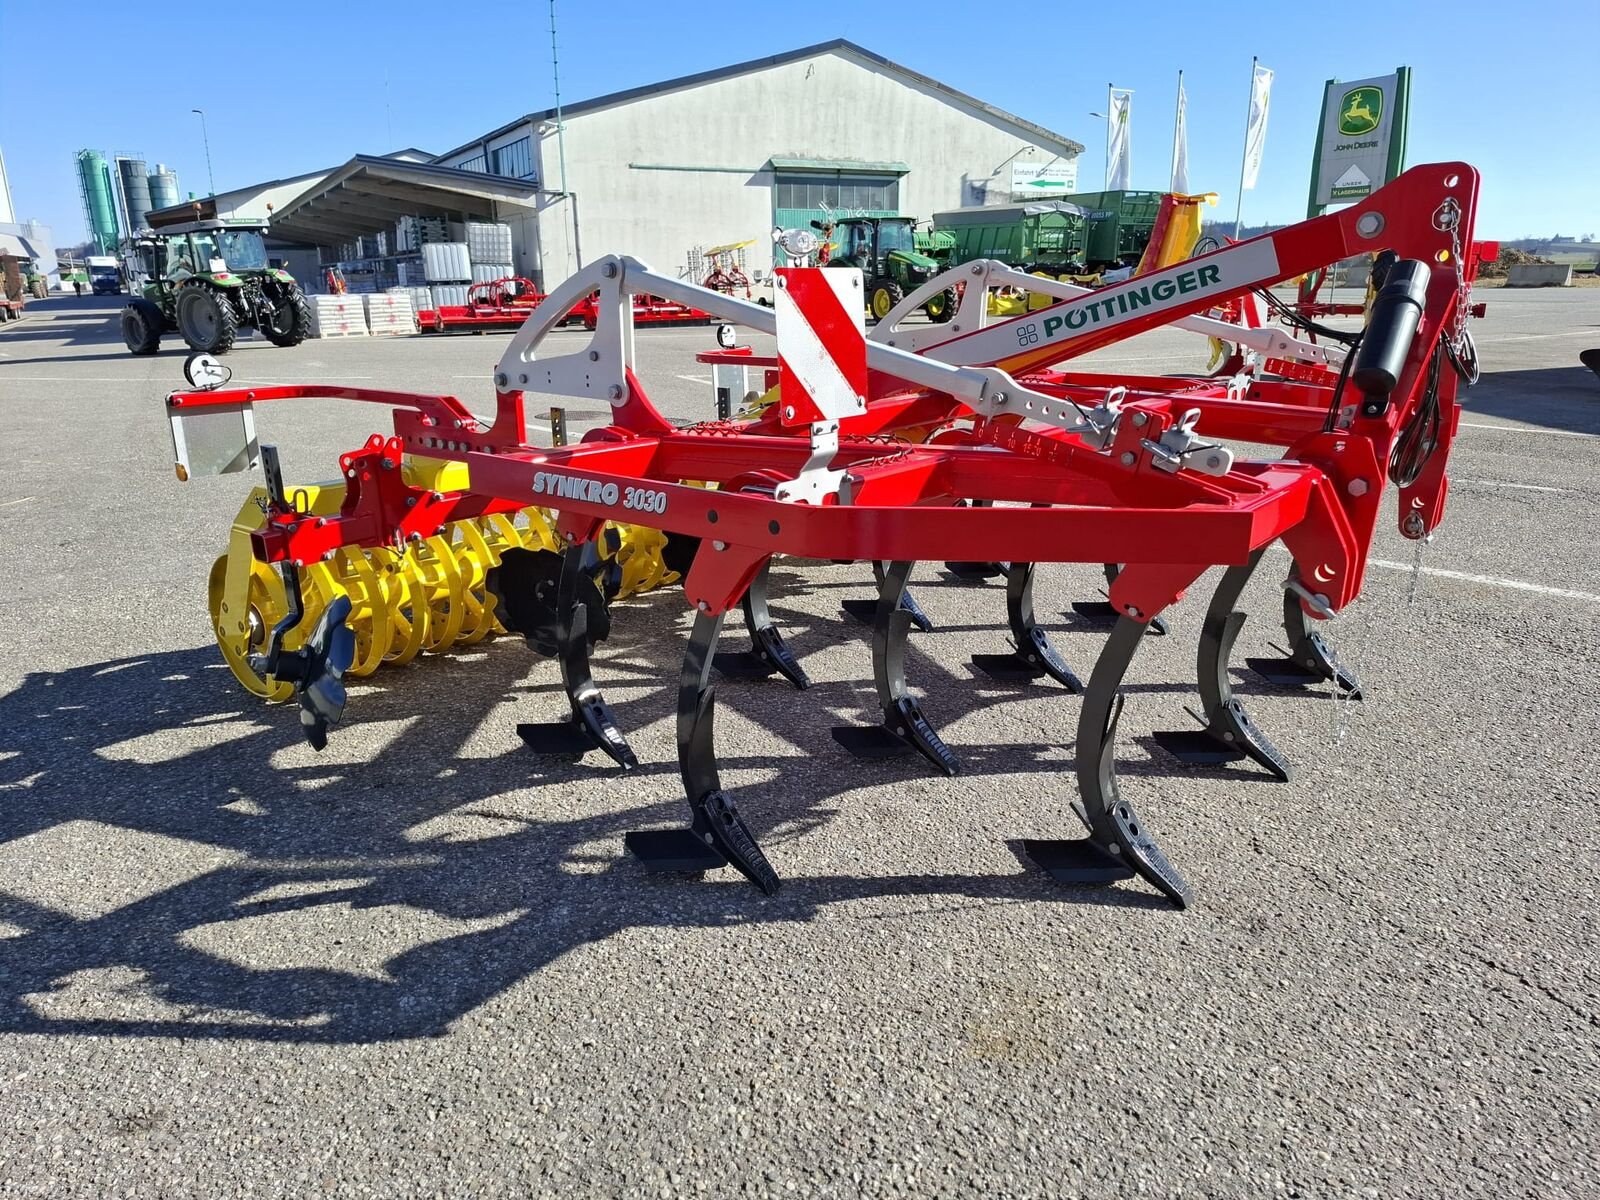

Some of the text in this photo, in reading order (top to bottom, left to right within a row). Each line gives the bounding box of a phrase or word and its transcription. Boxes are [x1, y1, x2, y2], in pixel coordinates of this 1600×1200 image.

[1333, 140, 1379, 152] JOHN DEERE
[1043, 264, 1221, 338] PÖTTINGER
[532, 472, 667, 515] SYNKRO 3030
